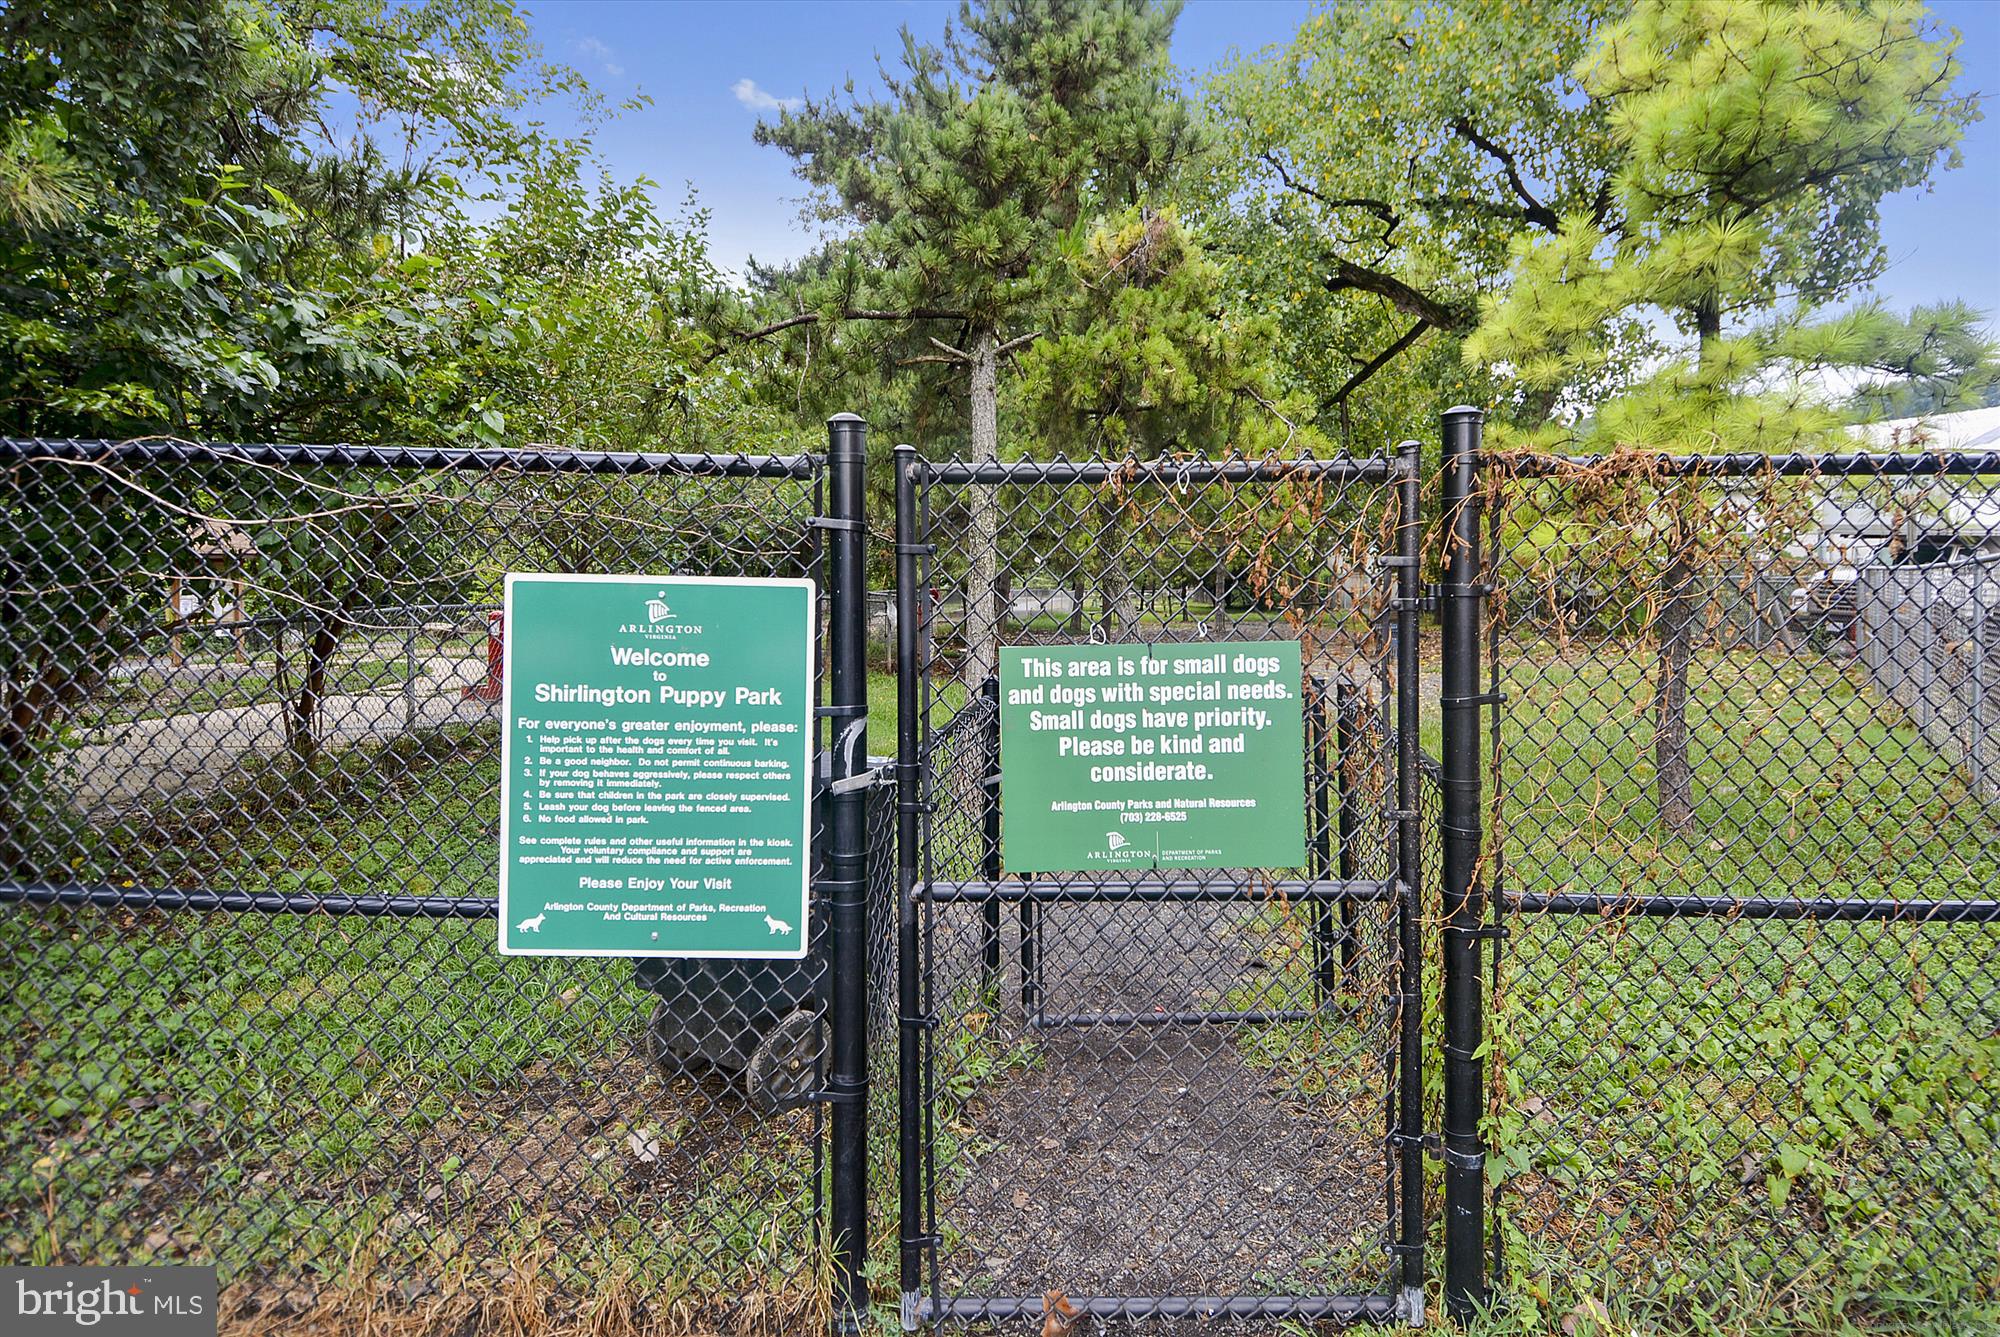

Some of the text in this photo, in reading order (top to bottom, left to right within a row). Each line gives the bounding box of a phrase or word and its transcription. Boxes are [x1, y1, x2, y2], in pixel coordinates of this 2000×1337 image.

[618, 624, 702, 634] ARLINGTON
[610, 648, 710, 667] Welcome
[1020, 653, 1280, 678] This area is for small dogs
[652, 670, 667, 681] to
[534, 683, 782, 708] Shirlington Puppy Park
[1007, 679, 1293, 708] and dogs with special needs.
[517, 717, 798, 734] For everyone's greater enjoyment, please:
[1029, 706, 1272, 733] Small dogs have priority.
[526, 734, 778, 747] 1. Help pick up after the dogs every time you visit. It's
[1059, 732, 1245, 756] Please be kind and
[539, 744, 730, 755] important to the health and comfort of all.
[524, 755, 533, 765] 2.
[539, 756, 552, 765] Be
[563, 757, 588, 767] good
[590, 757, 632, 767] neighbor.
[638, 757, 652, 766] Do
[653, 758, 669, 766] not
[671, 758, 700, 768] permit
[703, 758, 752, 767] continuous
[754, 759, 790, 769] barking.
[523, 767, 791, 780] 3. If your dog behaves aggressively, please respect others
[1090, 760, 1213, 783] considerate.
[538, 778, 662, 789] by removing it immediately.
[522, 789, 533, 798] 4.
[538, 789, 552, 798] Be
[554, 791, 574, 799] sure
[577, 790, 595, 799] that
[597, 790, 633, 799] children
[635, 791, 645, 799] in
[647, 791, 662, 800] the
[664, 791, 685, 801] park
[705, 792, 737, 802] closely
[740, 792, 791, 802] supervised.
[523, 801, 752, 813] 5. Leash your dog before leaving the fenced area.
[1050, 797, 1256, 813] Arlington County Parks and Natural Resources
[522, 813, 649, 825] 6. No food allowed in park.
[1119, 810, 1187, 824] (703) 228-6525
[518, 835, 793, 847] See complete rules and other useful information in the kiosk.
[560, 845, 752, 857] Your voluntary compliance and support are
[1087, 850, 1151, 859] ARLINGTON
[518, 854, 792, 865] appreciated and will reduce the need for active enforcement.
[579, 876, 732, 891] Please Enjoy Your Visit
[543, 901, 766, 913] Arlington County Department of Parks, Recreation
[603, 912, 707, 921] And Cultural Resources
